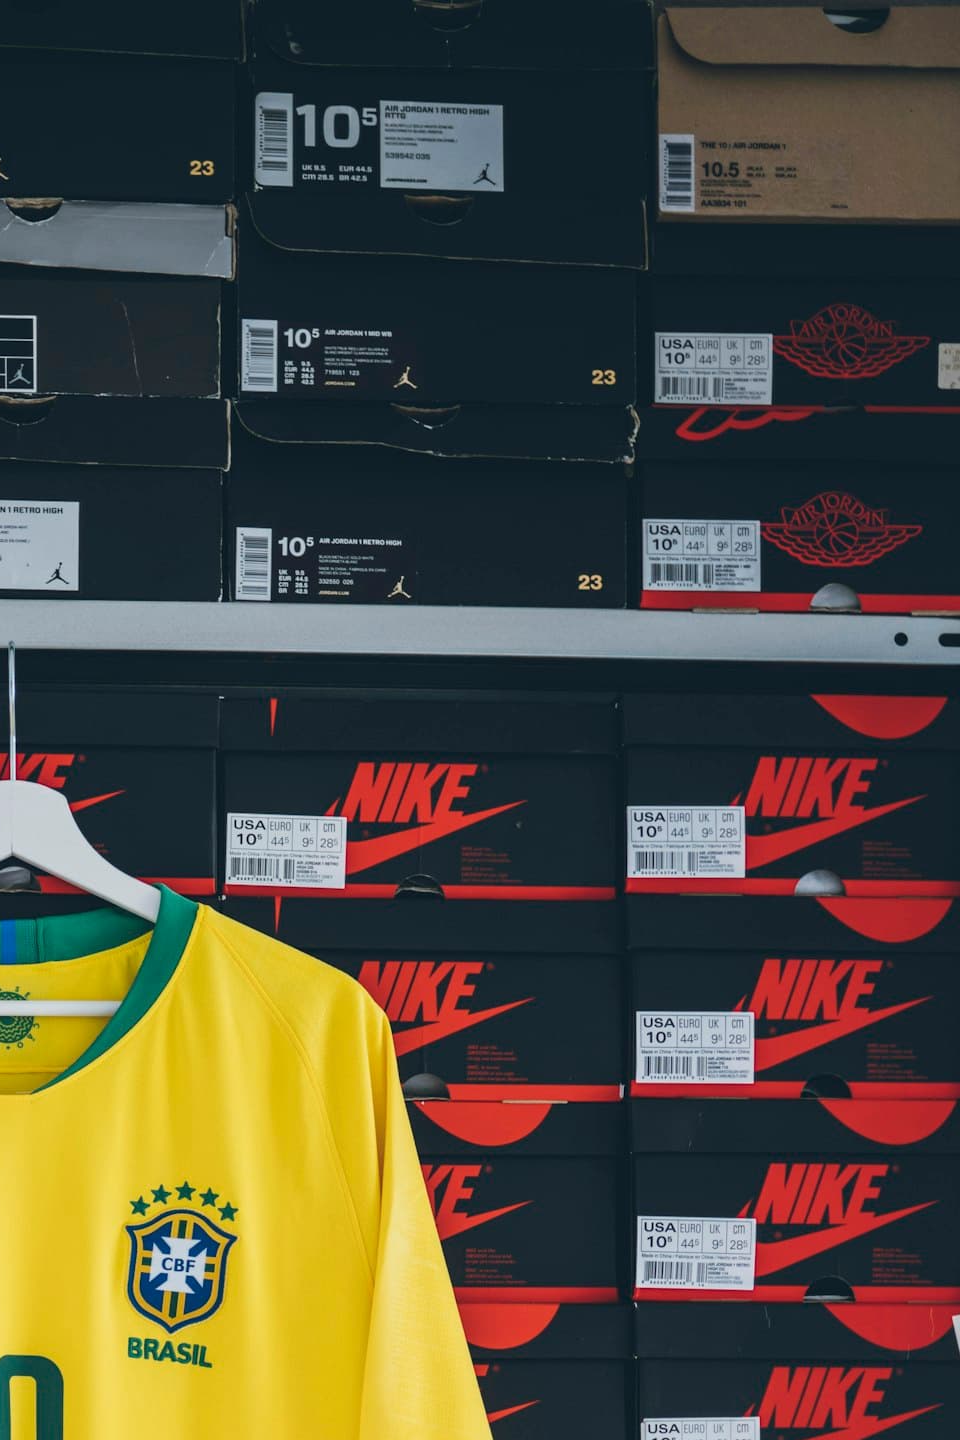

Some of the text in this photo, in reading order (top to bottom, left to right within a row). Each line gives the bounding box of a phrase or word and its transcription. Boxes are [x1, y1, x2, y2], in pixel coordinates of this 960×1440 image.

[190, 161, 214, 175] 23
[701, 162, 739, 178] 10.5
[800, 304, 892, 338] AIR JORDAN
[662, 339, 694, 350] USA
[591, 370, 616, 385] 23
[13, 506, 41, 514] RETRO
[43, 506, 64, 514] HIGH
[791, 494, 885, 527] AIR JORDAN
[649, 524, 681, 536] USA
[578, 575, 603, 590] 23
[340, 762, 478, 824] NIKE
[745, 756, 878, 818] NIKE
[233, 819, 266, 831] USA
[633, 812, 666, 823] USA
[748, 959, 883, 1020] NIKE
[643, 1018, 675, 1029] USA
[752, 1163, 889, 1225] NIKE
[161, 1257, 196, 1273] CBF
[128, 1336, 213, 1369] BRASIL
[759, 1366, 893, 1429] NIKE
[647, 1423, 680, 1435] USA
